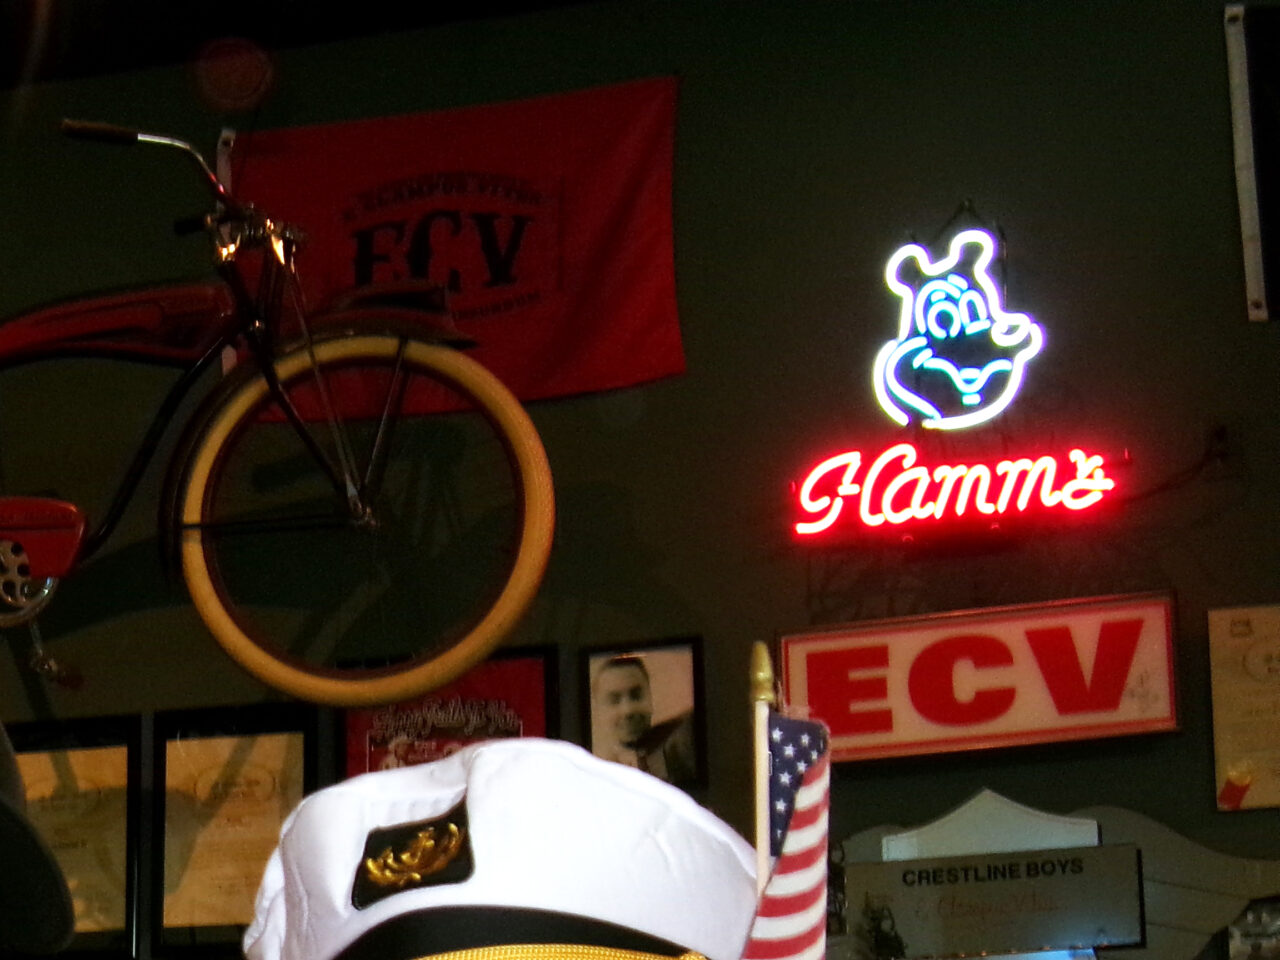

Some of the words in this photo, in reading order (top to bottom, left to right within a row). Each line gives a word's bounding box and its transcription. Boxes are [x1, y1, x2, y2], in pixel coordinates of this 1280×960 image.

[352, 209, 536, 293] ECV
[793, 441, 1116, 536] Hamm's
[806, 618, 1144, 737] ECV
[902, 864, 1021, 887] CRESTLINE
[1025, 857, 1084, 878] BOYS
